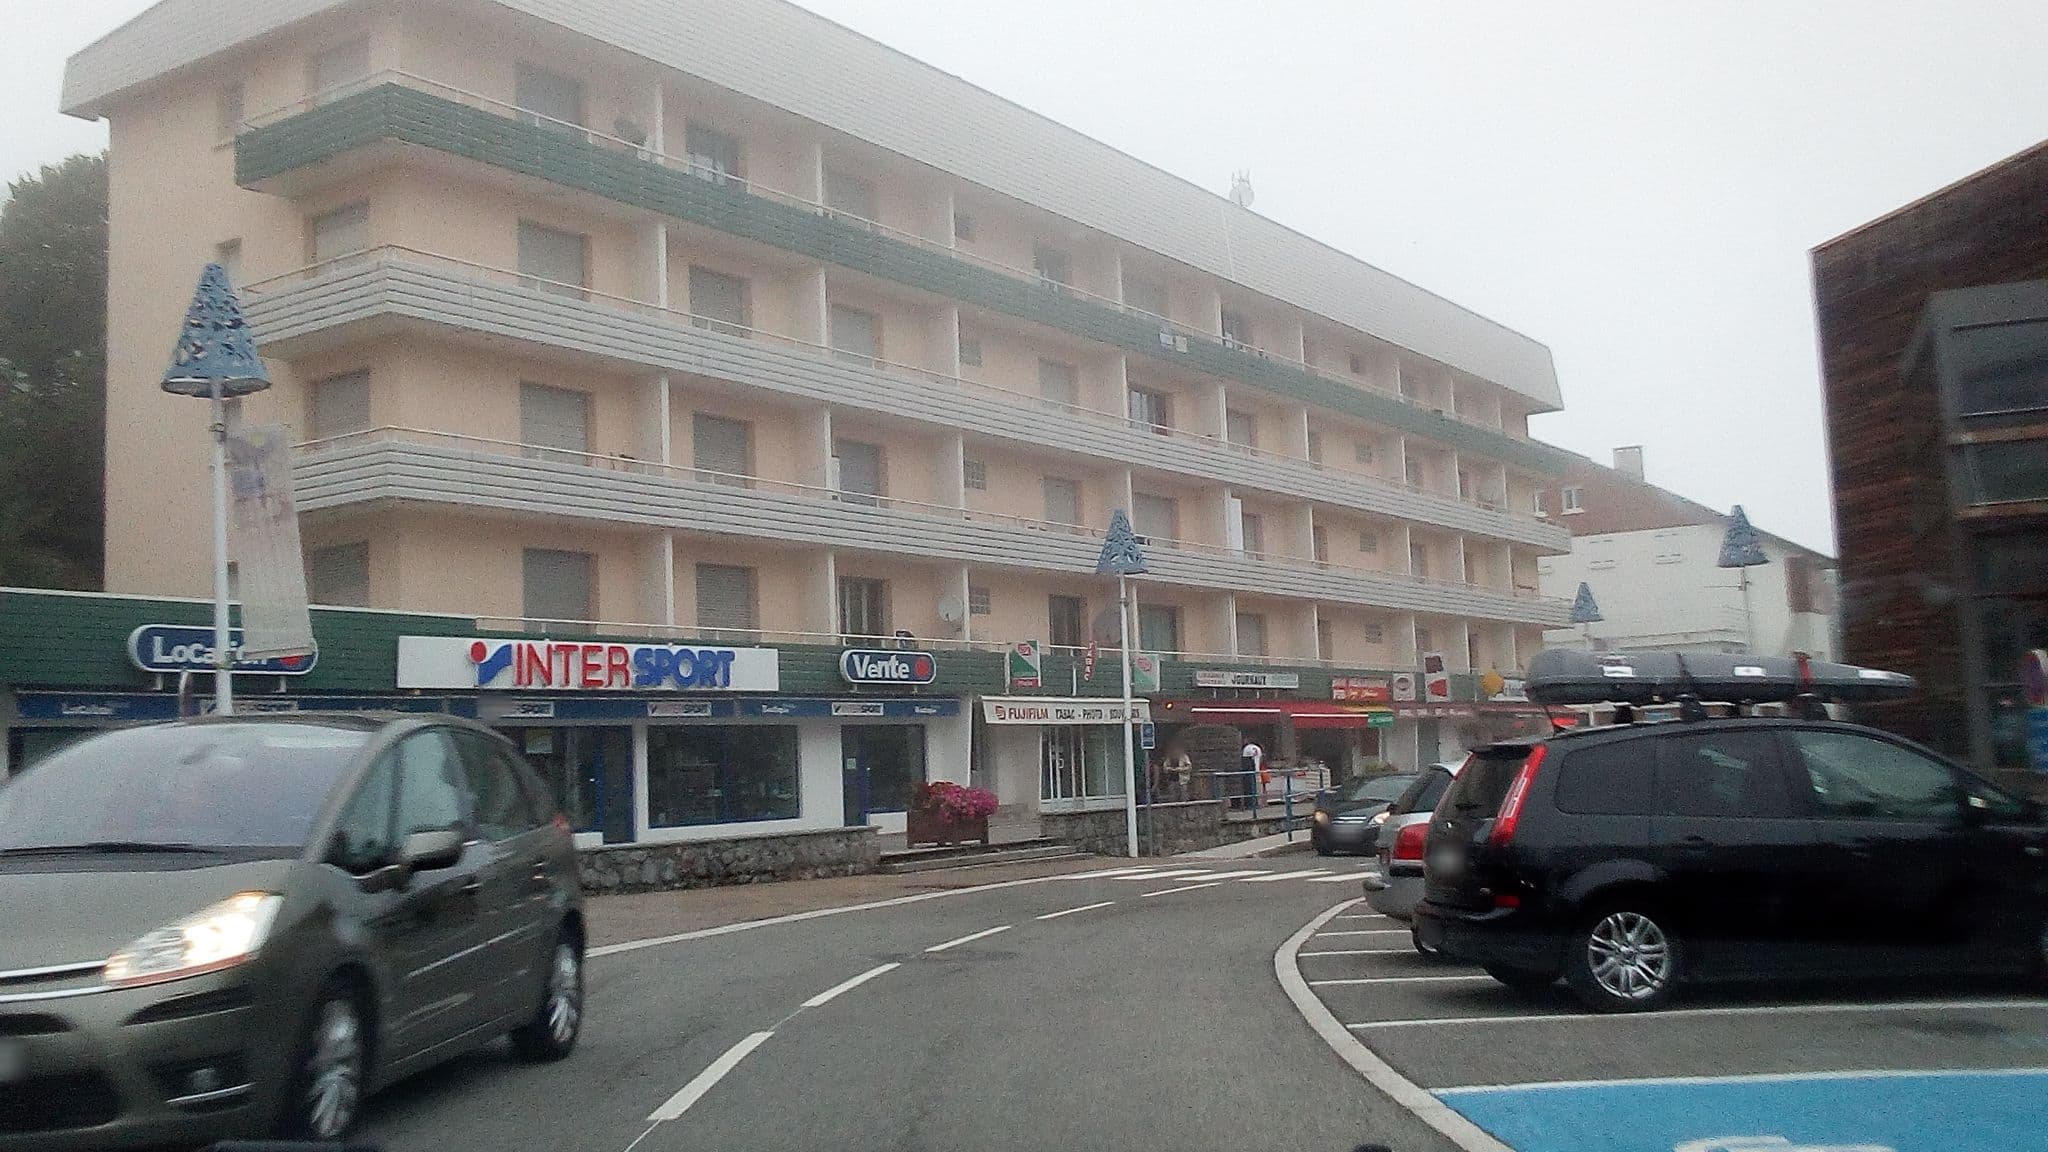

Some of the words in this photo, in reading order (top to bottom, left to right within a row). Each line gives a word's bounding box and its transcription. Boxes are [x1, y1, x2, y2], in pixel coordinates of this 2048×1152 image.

[514, 641, 736, 689] INTERSPORT
[852, 653, 910, 680] Vente
[1008, 707, 1049, 720] FUJIFILM
